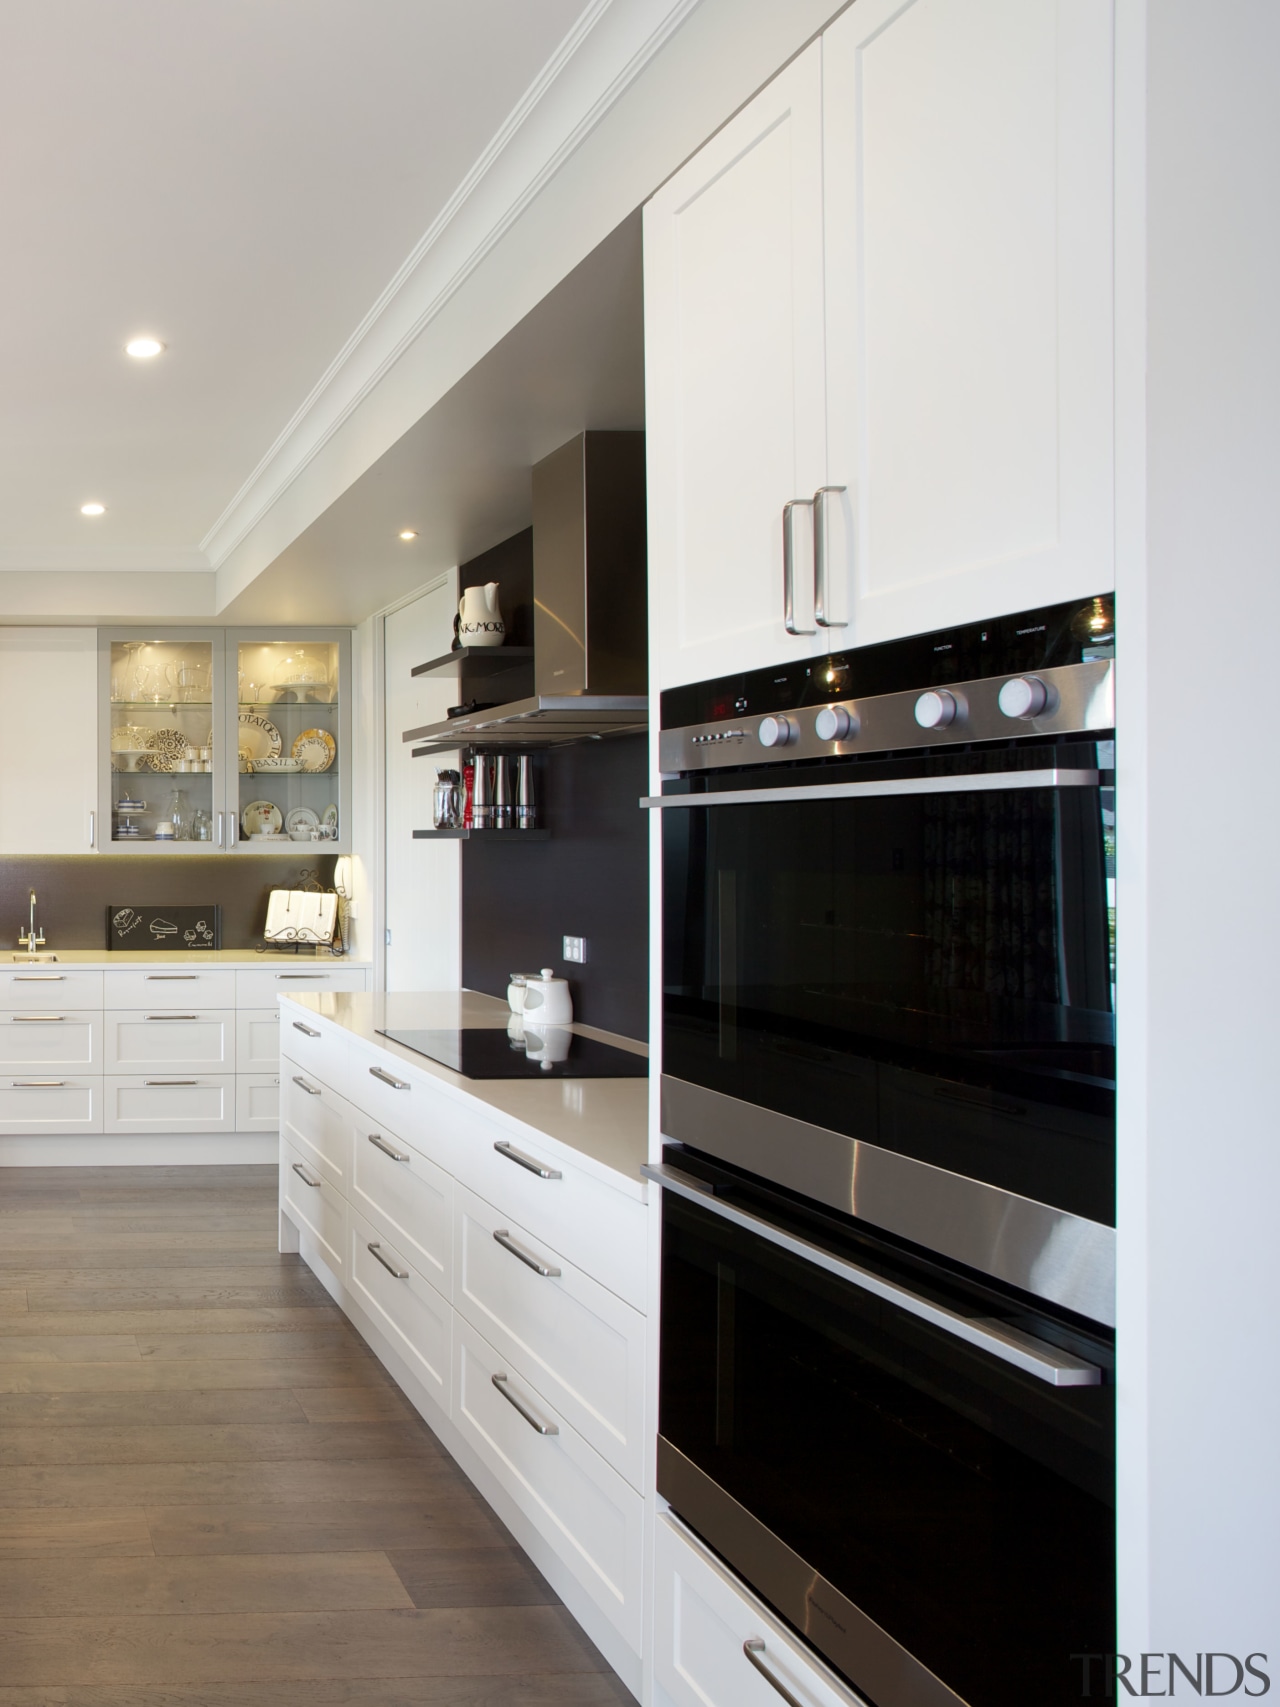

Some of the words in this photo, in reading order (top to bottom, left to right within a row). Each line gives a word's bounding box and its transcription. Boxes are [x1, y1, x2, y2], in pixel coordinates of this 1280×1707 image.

[475, 621, 505, 633] MORE
[1016, 624, 1046, 635] TEMPERATURE
[933, 644, 953, 652] FUNCTION
[254, 758, 289, 768] BASIL
